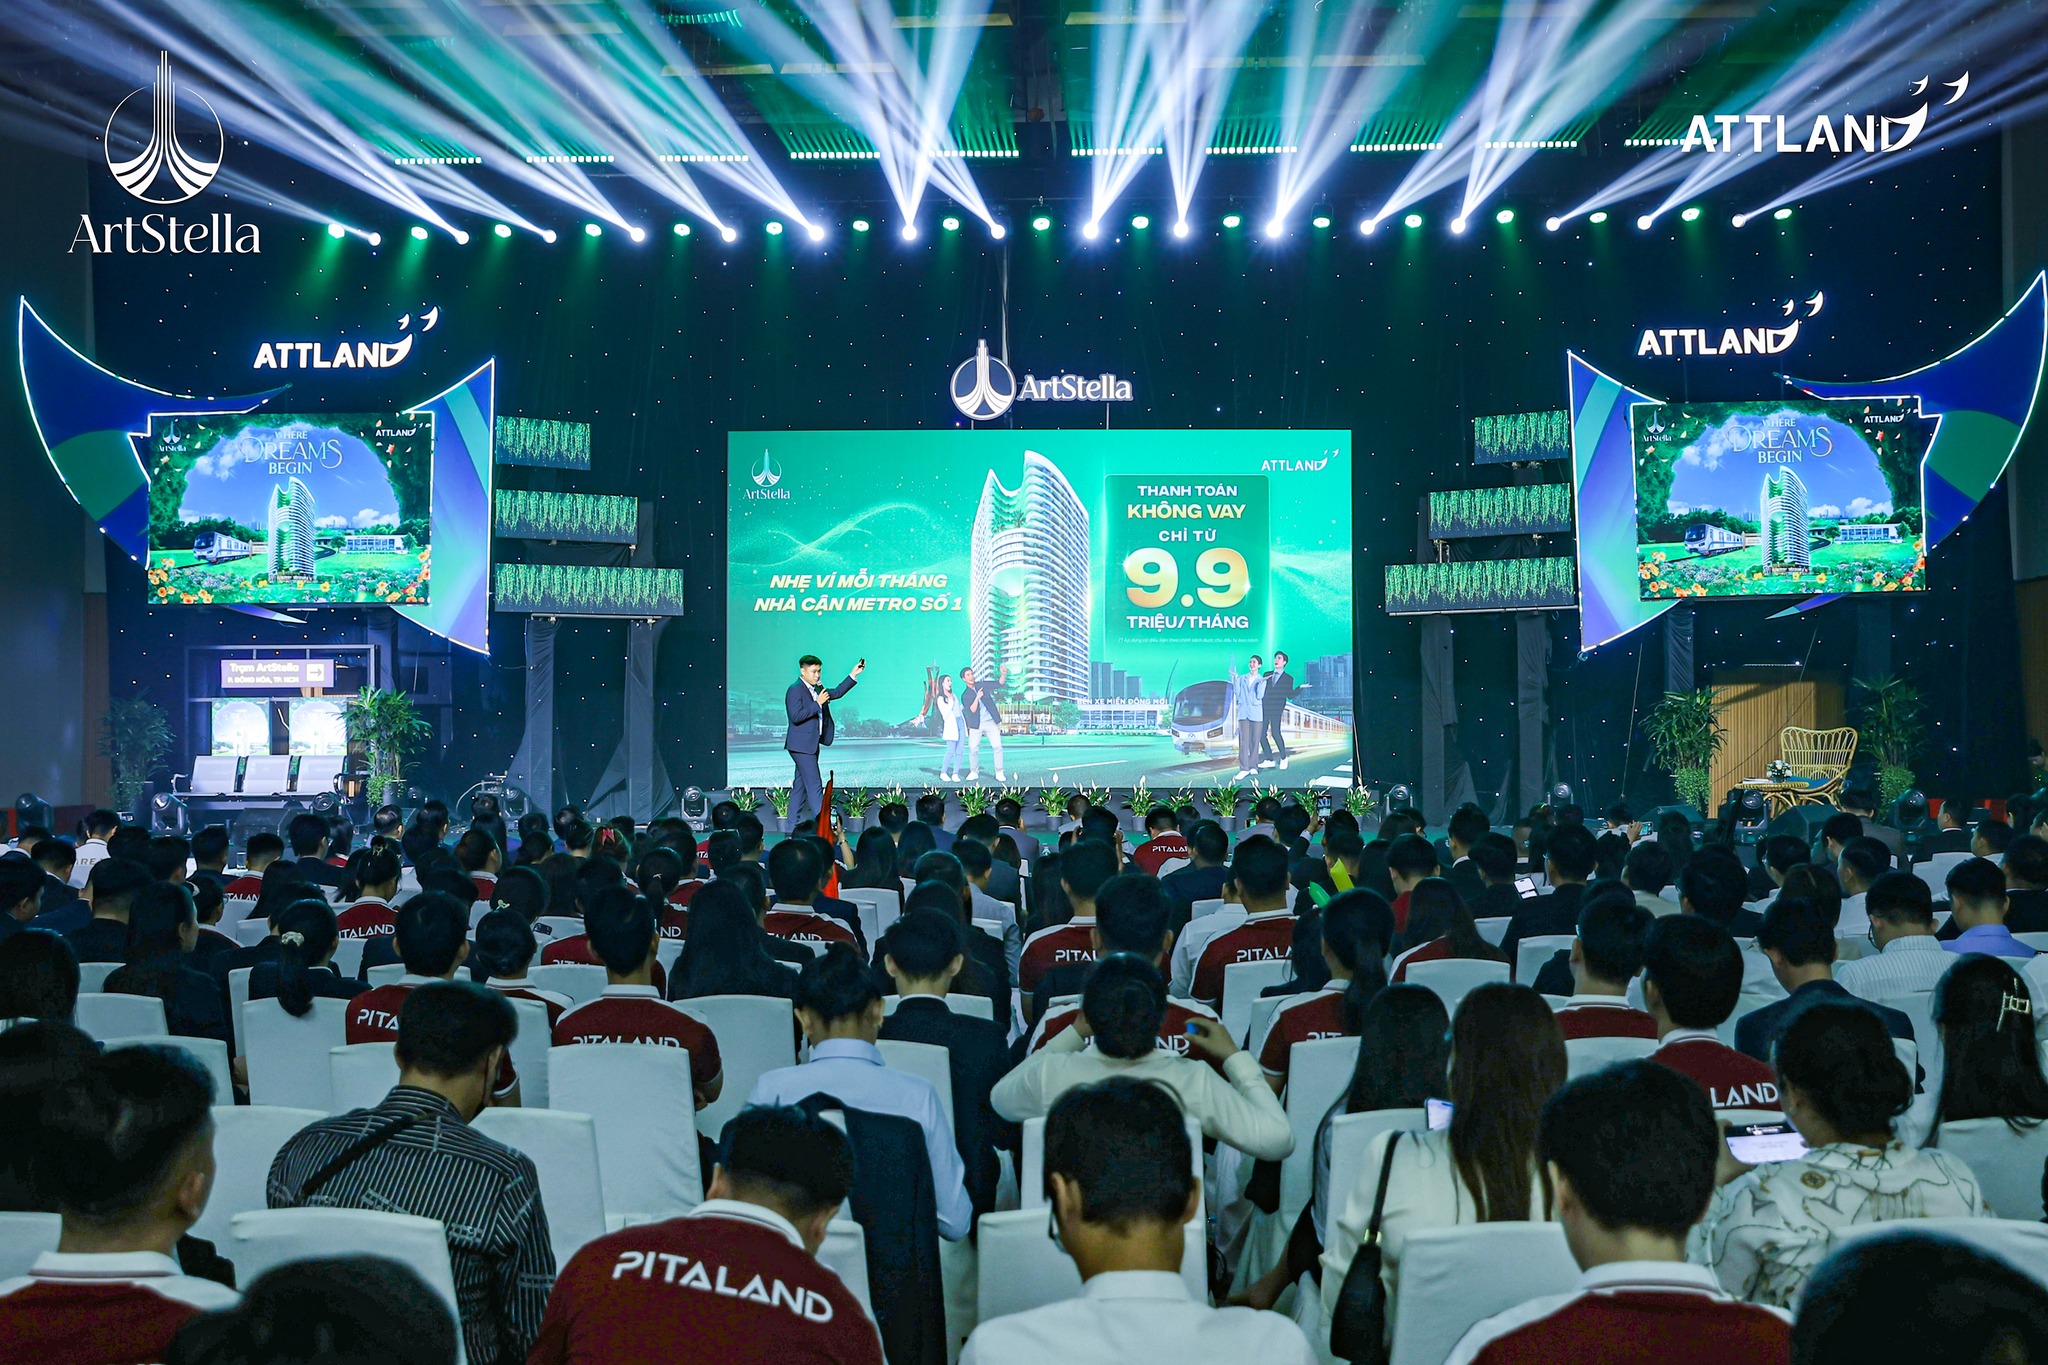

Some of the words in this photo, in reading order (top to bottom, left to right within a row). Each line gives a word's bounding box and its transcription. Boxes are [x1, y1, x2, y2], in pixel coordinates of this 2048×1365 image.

[1638, 319, 1799, 356] ATTLAND
[254, 334, 413, 369] ATTLAND
[1017, 374, 1134, 401] ArtStella
[1762, 418, 1796, 427] WHERE
[1864, 413, 1905, 424] ATTLAND
[274, 430, 308, 439] WHERE
[374, 427, 417, 437] ATTLAND
[1726, 423, 1833, 458] DREAMS
[238, 436, 343, 470] DREAMS
[1757, 450, 1803, 464] BEGIN
[268, 461, 313, 475] BEGIN
[1261, 457, 1329, 472] ATTLAND
[742, 488, 791, 500] ArtStella
[1137, 485, 1192, 497] THANH
[1194, 483, 1238, 497] TOÁN
[1127, 500, 1203, 519] KHÔNG
[1206, 504, 1247, 519] VAY
[1158, 527, 1188, 542] CHỈ
[1193, 528, 1217, 542] TỪ
[769, 574, 812, 594] NHẸ
[815, 571, 838, 589] VÍ
[836, 567, 875, 589] MỖI
[878, 571, 948, 589] THÁNG
[1123, 547, 1251, 609] 9.9
[754, 594, 797, 612] NHÀ
[801, 594, 845, 616] CẬN
[846, 597, 917, 612] METRO
[920, 592, 952, 612] SỐ
[950, 597, 963, 612] 1
[1126, 613, 1250, 632] TRIỆU/THÁNG
[1152, 845, 1188, 853] PITALA
[338, 923, 397, 939] ITALAND
[1236, 945, 1293, 962] PITALA
[357, 1008, 399, 1030] PITA
[1709, 1082, 1779, 1108] LAND
[612, 1250, 833, 1324] PITALAND
